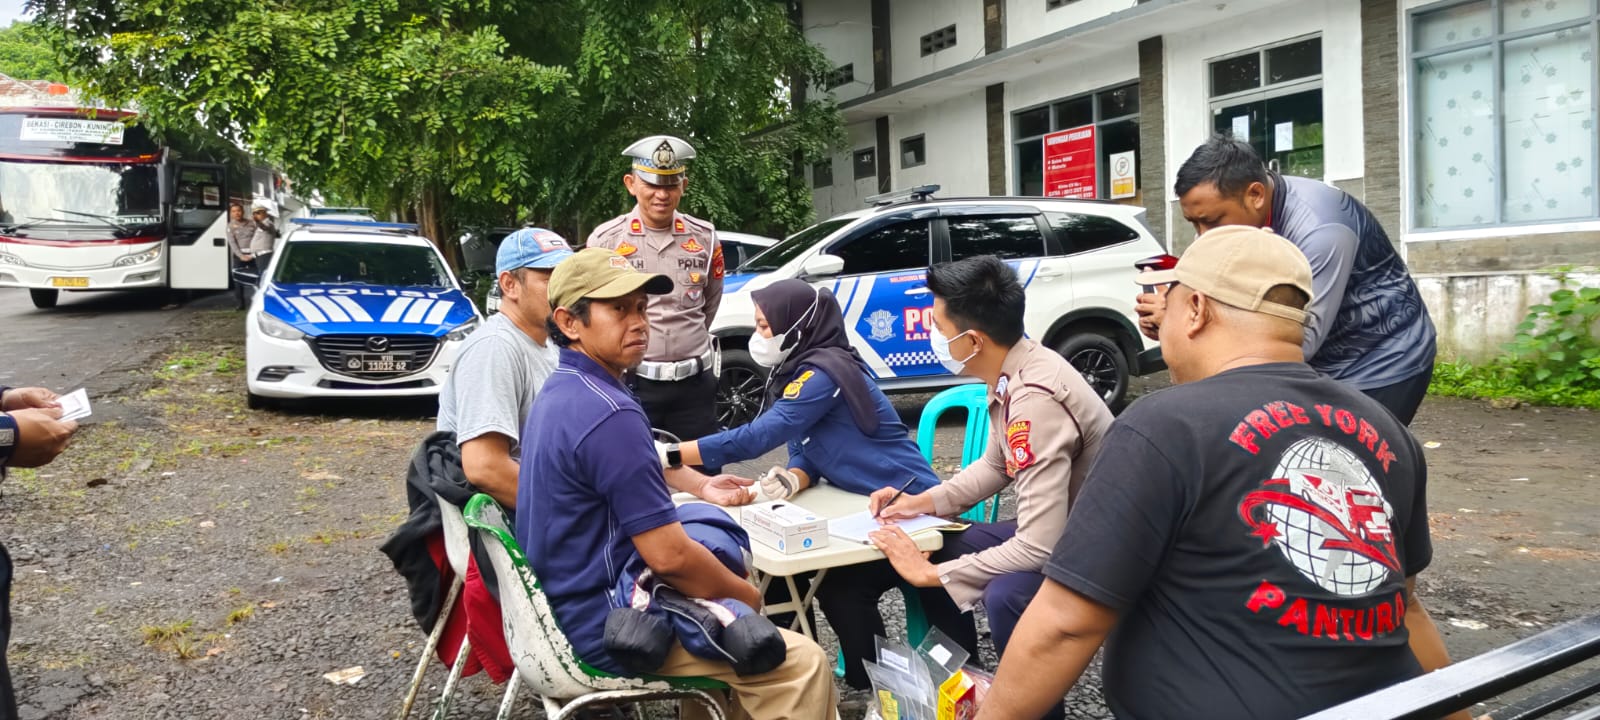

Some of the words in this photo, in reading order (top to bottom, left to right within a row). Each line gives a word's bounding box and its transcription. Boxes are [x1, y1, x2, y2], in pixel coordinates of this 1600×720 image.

[26, 120, 50, 128] BEKASI
[54, 121, 82, 129] CIREBON
[299, 288, 438, 299] POLISI
[905, 332, 930, 341] LAL
[1228, 400, 1311, 456] FREE
[1314, 403, 1398, 474] YORK
[1245, 579, 1406, 641] PANTURA
